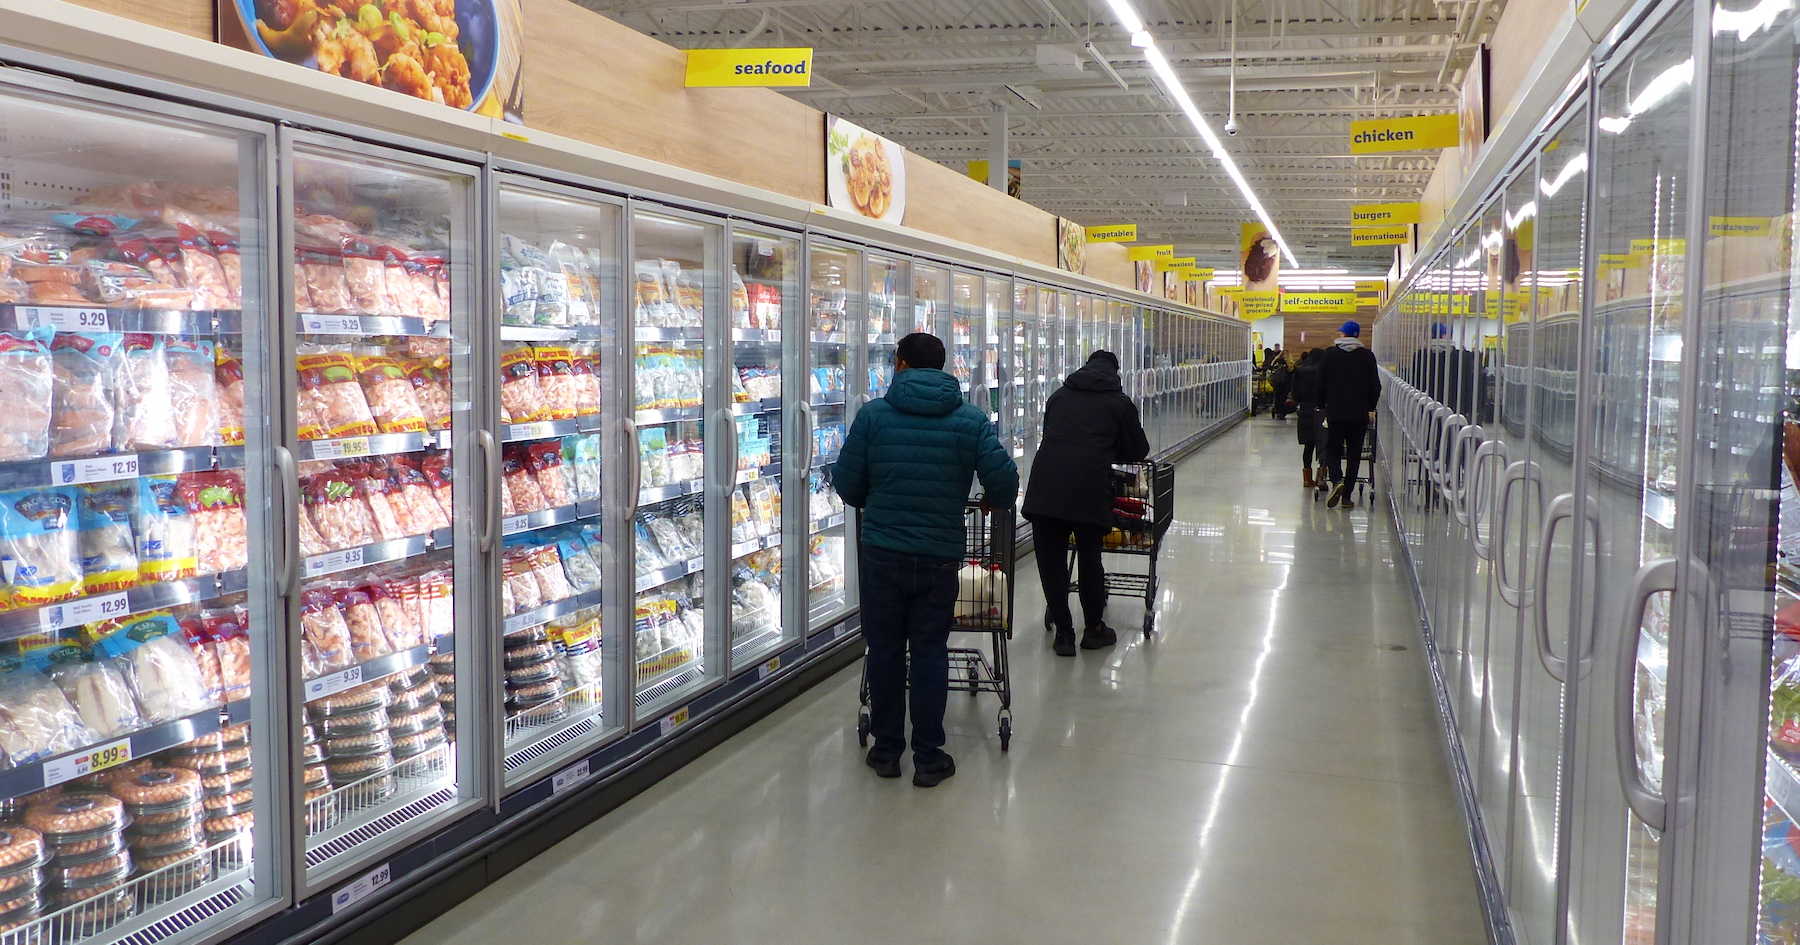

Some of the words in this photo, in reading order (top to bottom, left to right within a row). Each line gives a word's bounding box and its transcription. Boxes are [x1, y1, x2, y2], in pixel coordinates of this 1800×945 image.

[735, 60, 806, 75] seafood
[1354, 129, 1414, 144] chicken
[1353, 211, 1391, 221] burgers
[1092, 230, 1134, 240] vegetables
[1353, 232, 1407, 241] international
[1284, 297, 1344, 305] self-checkout
[79, 312, 105, 326] 9.29
[342, 319, 359, 330] 9.29
[342, 441, 362, 453] 19.95
[112, 460, 137, 474] 12.19
[515, 518, 527, 530] 9.25
[345, 549, 361, 563] 9.35
[101, 598, 127, 614] 12.99
[343, 667, 360, 683] 9.39
[91, 746, 119, 768] 8.99
[371, 868, 389, 886] 12.99
